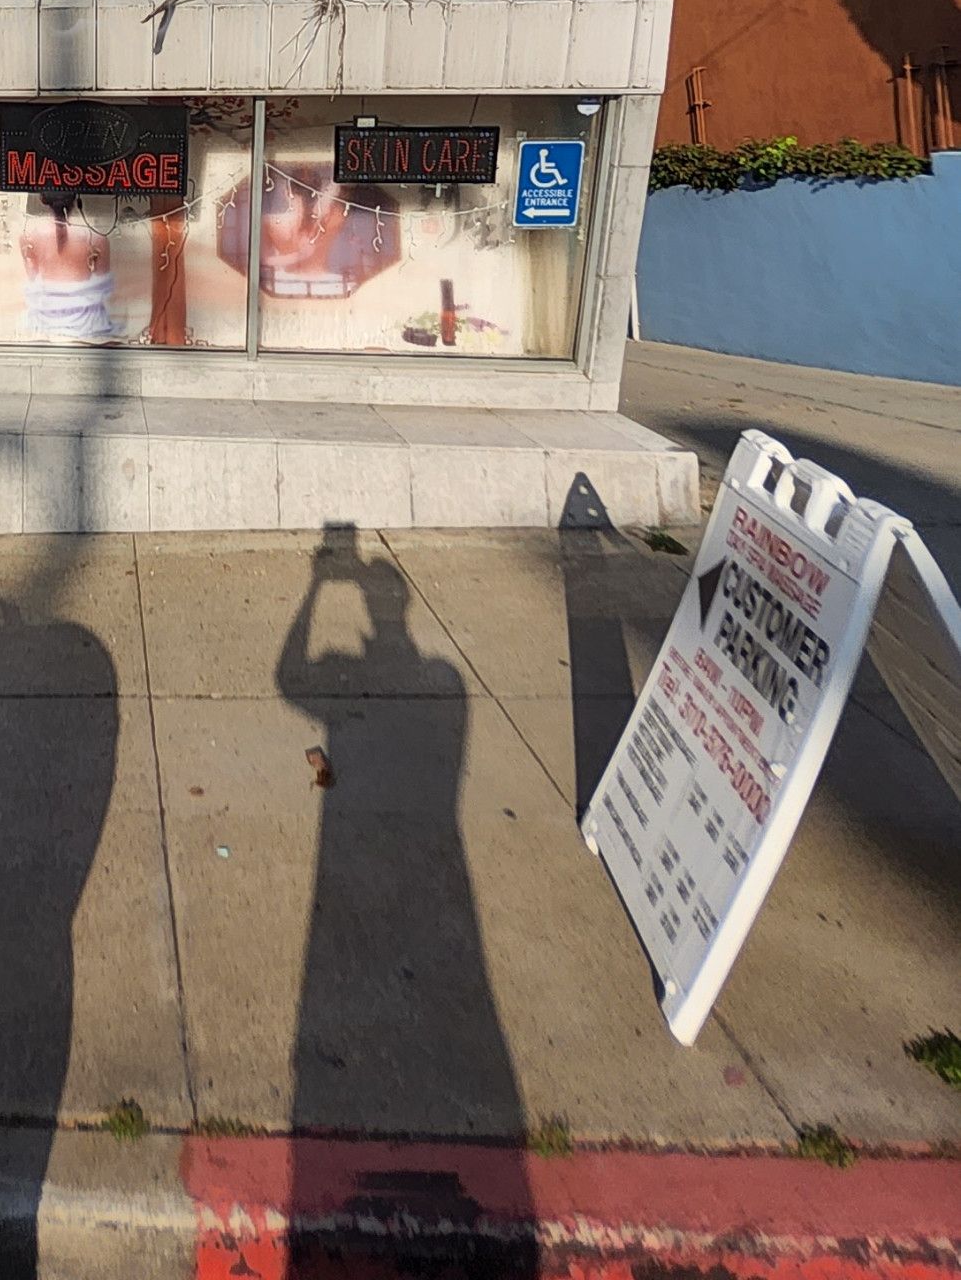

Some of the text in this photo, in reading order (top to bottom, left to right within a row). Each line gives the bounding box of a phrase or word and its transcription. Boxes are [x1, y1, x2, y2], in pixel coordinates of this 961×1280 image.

[39, 120, 128, 150] OPEN
[7, 150, 180, 189] MASSAGE
[346, 138, 488, 173] SKIN CARE
[521, 188, 574, 198] ACCESSIBLE
[524, 197, 569, 207] ENTRANCE
[731, 505, 831, 597] RAINBOW
[722, 559, 831, 689] CUSTOMER
[713, 609, 799, 726] PARKING
